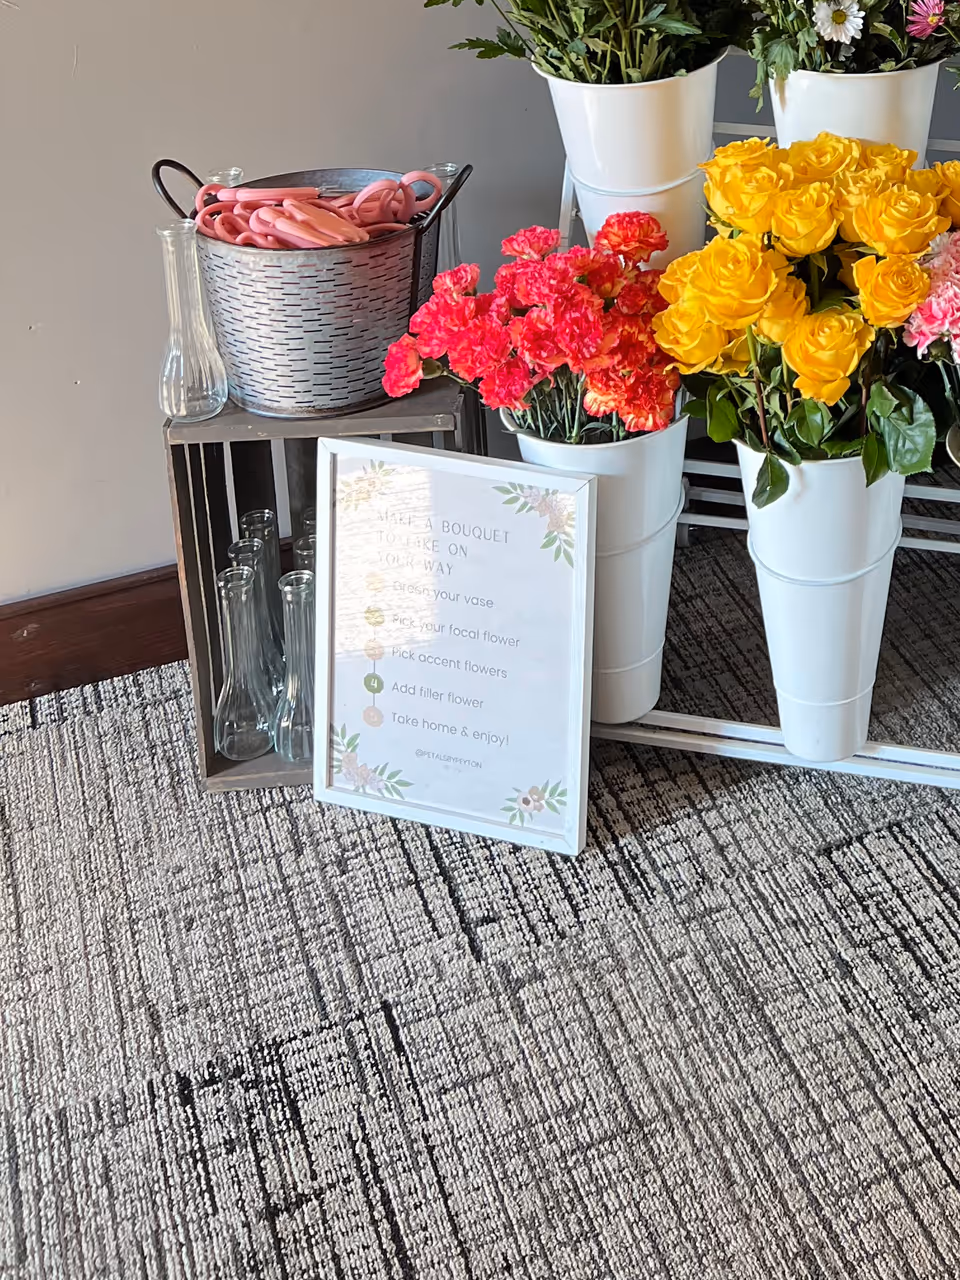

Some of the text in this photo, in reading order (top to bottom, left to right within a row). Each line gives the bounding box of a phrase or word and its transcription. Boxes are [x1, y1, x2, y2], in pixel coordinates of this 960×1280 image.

[425, 517, 433, 530] A
[442, 520, 510, 544] BOUQUET
[448, 542, 468, 558] ON
[424, 559, 454, 575] WAY
[433, 589, 460, 602] your
[464, 594, 495, 608] vase
[392, 614, 416, 629] Pick
[419, 620, 445, 634] your
[449, 623, 480, 640] focal
[483, 629, 520, 648] flower
[392, 646, 416, 661] Pick
[418, 653, 461, 670] accent
[464, 660, 508, 679] flowers
[370, 678, 484, 709] 4 Add filler flower
[392, 711, 419, 728] Take
[422, 718, 457, 736] home
[460, 726, 469, 738] &
[472, 729, 510, 748] enjoy!
